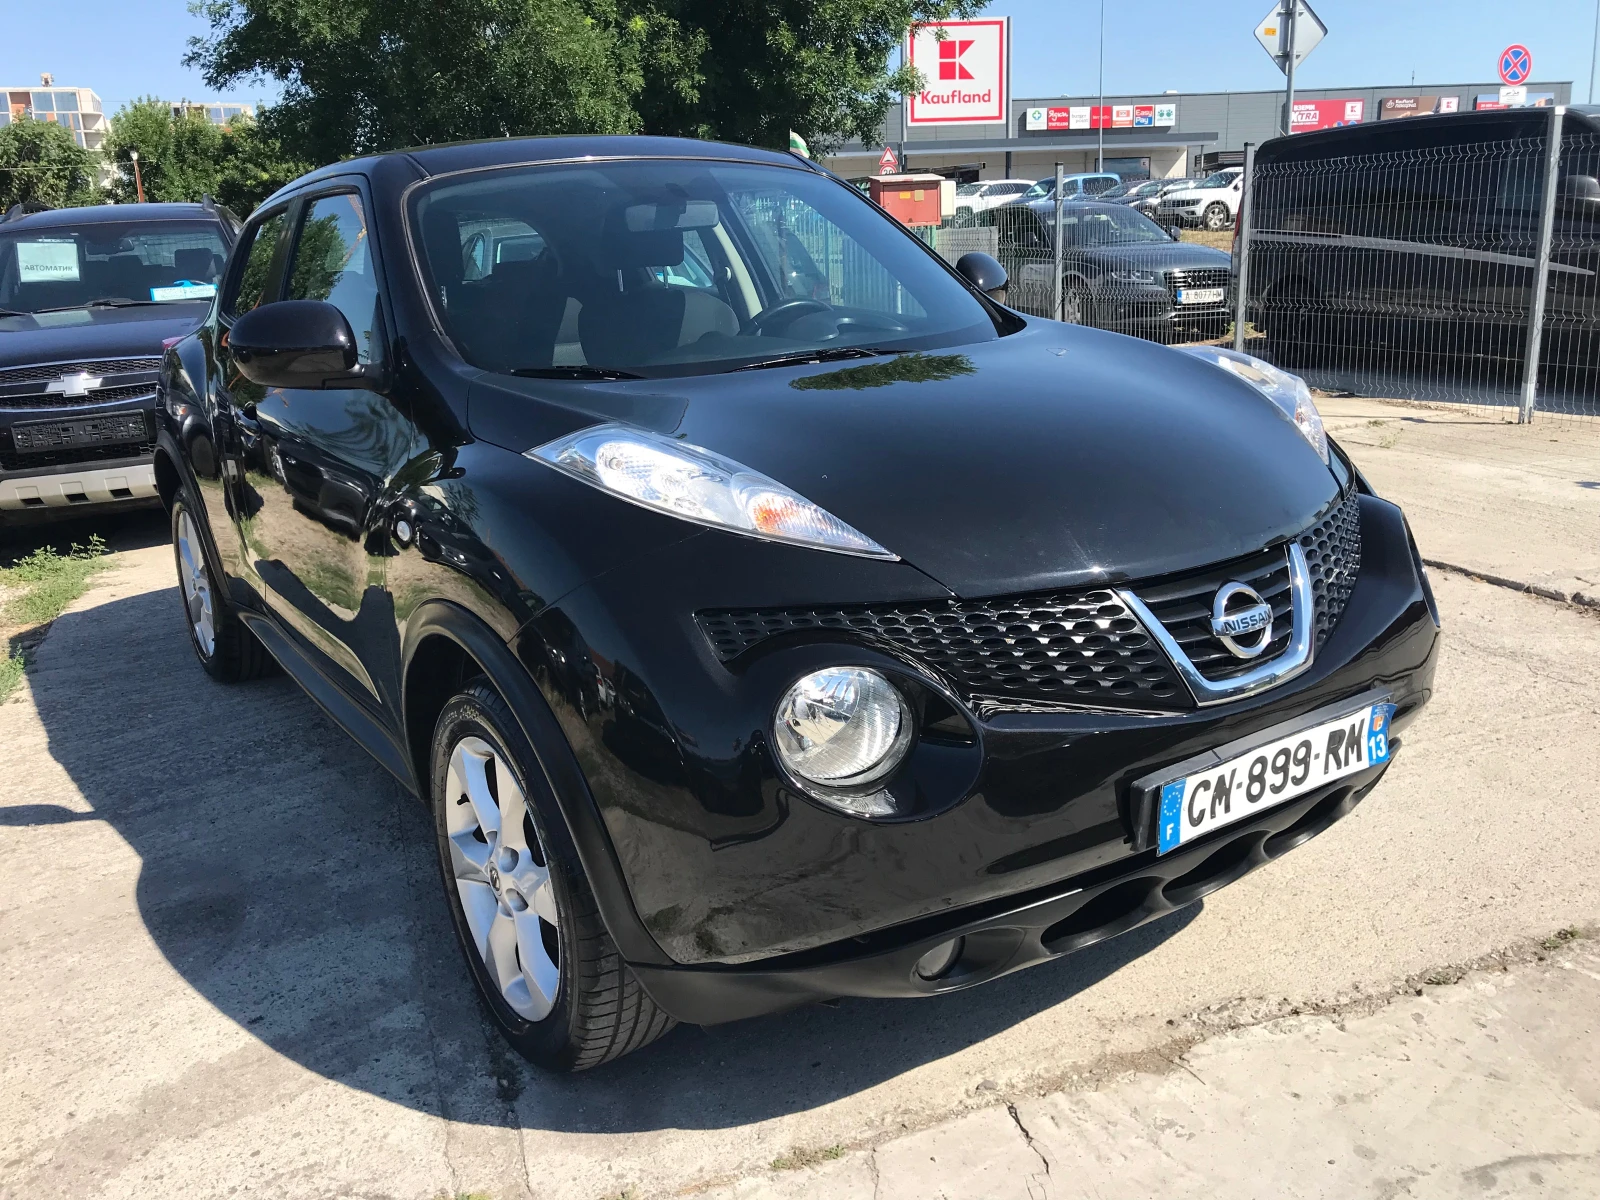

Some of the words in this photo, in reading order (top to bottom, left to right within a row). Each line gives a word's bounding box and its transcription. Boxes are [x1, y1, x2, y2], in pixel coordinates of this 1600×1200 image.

[939, 40, 975, 80] K
[921, 89, 991, 105] Kaufland
[1136, 109, 1152, 117] Easy
[24, 264, 73, 272] АВТОМАТИК
[1224, 609, 1272, 633] NISSAN
[1368, 733, 1387, 760] 13
[1187, 717, 1366, 828] CN-899-RM
[1165, 823, 1175, 841] F
